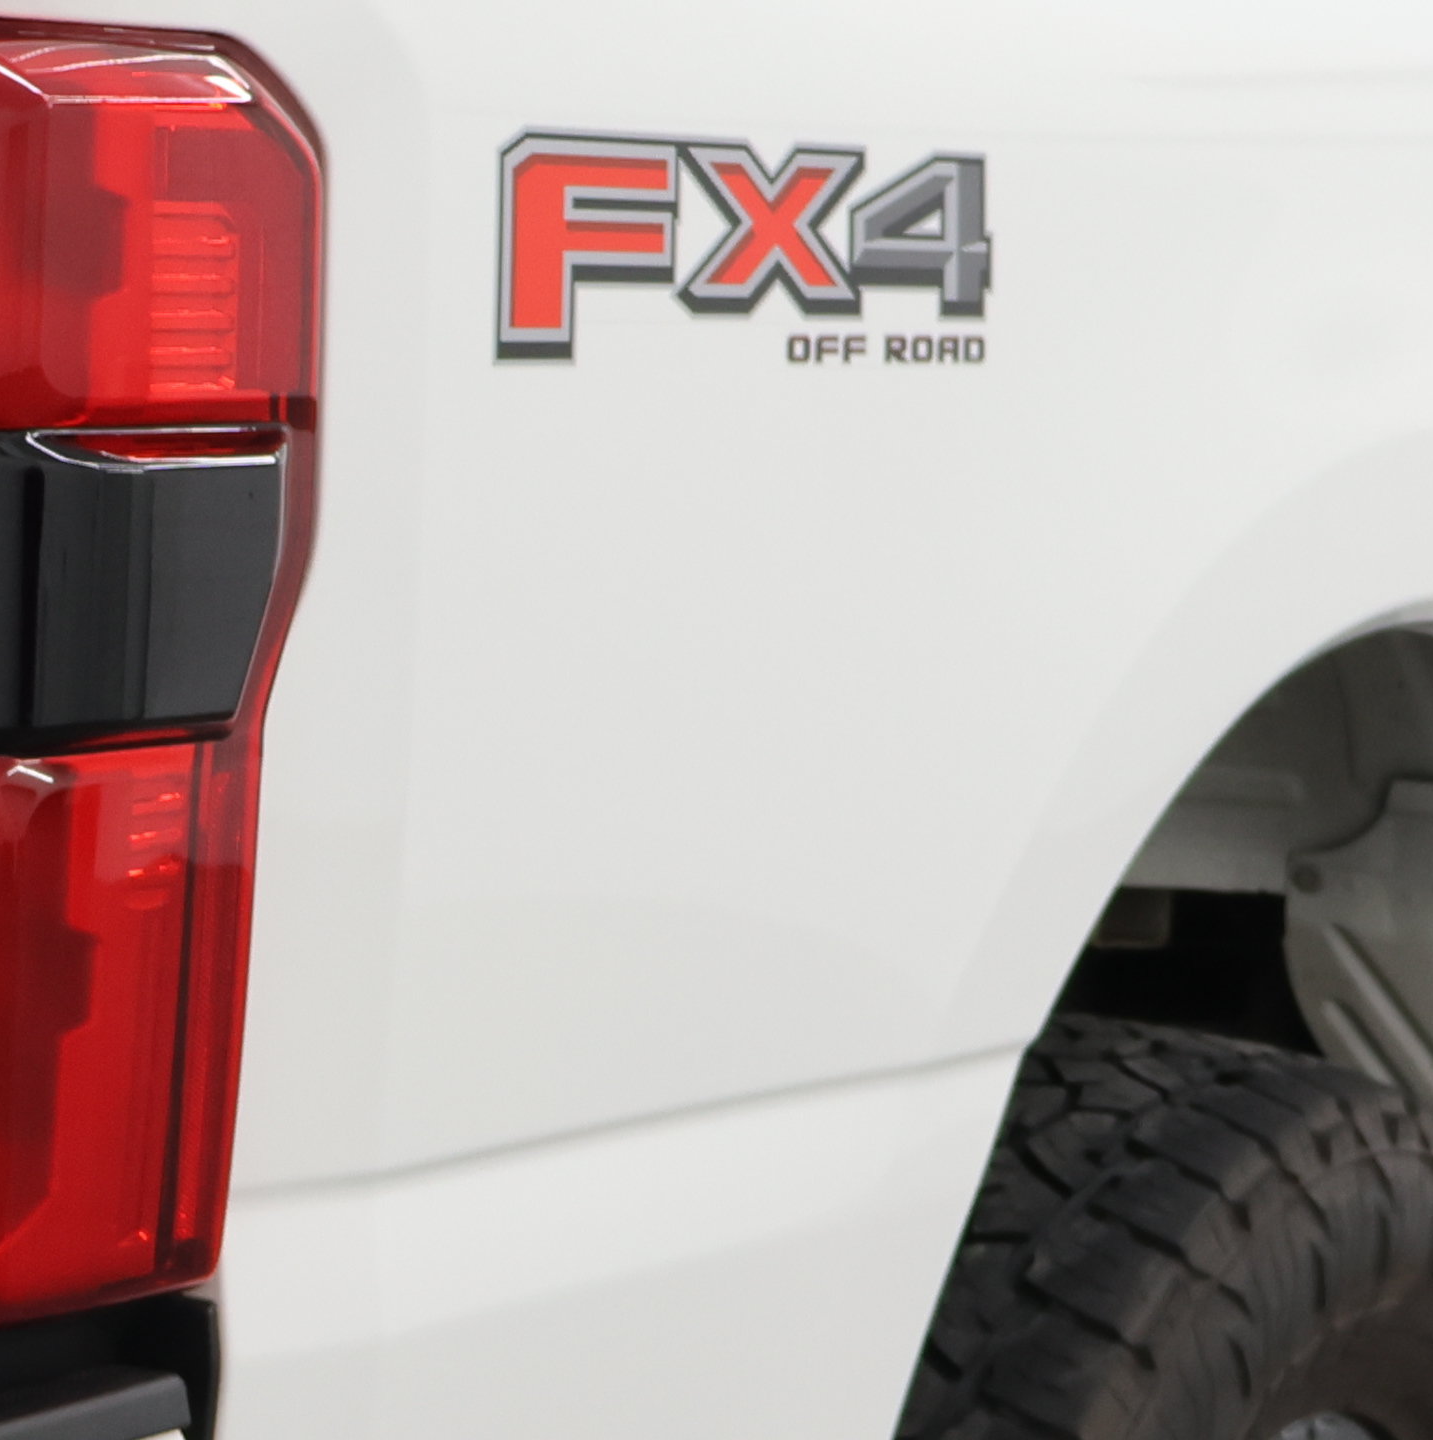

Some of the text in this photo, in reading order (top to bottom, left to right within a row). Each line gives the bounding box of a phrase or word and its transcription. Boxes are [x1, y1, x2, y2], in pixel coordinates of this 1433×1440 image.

[495, 127, 992, 363] FX4
[787, 334, 985, 364] OFF ROAD
